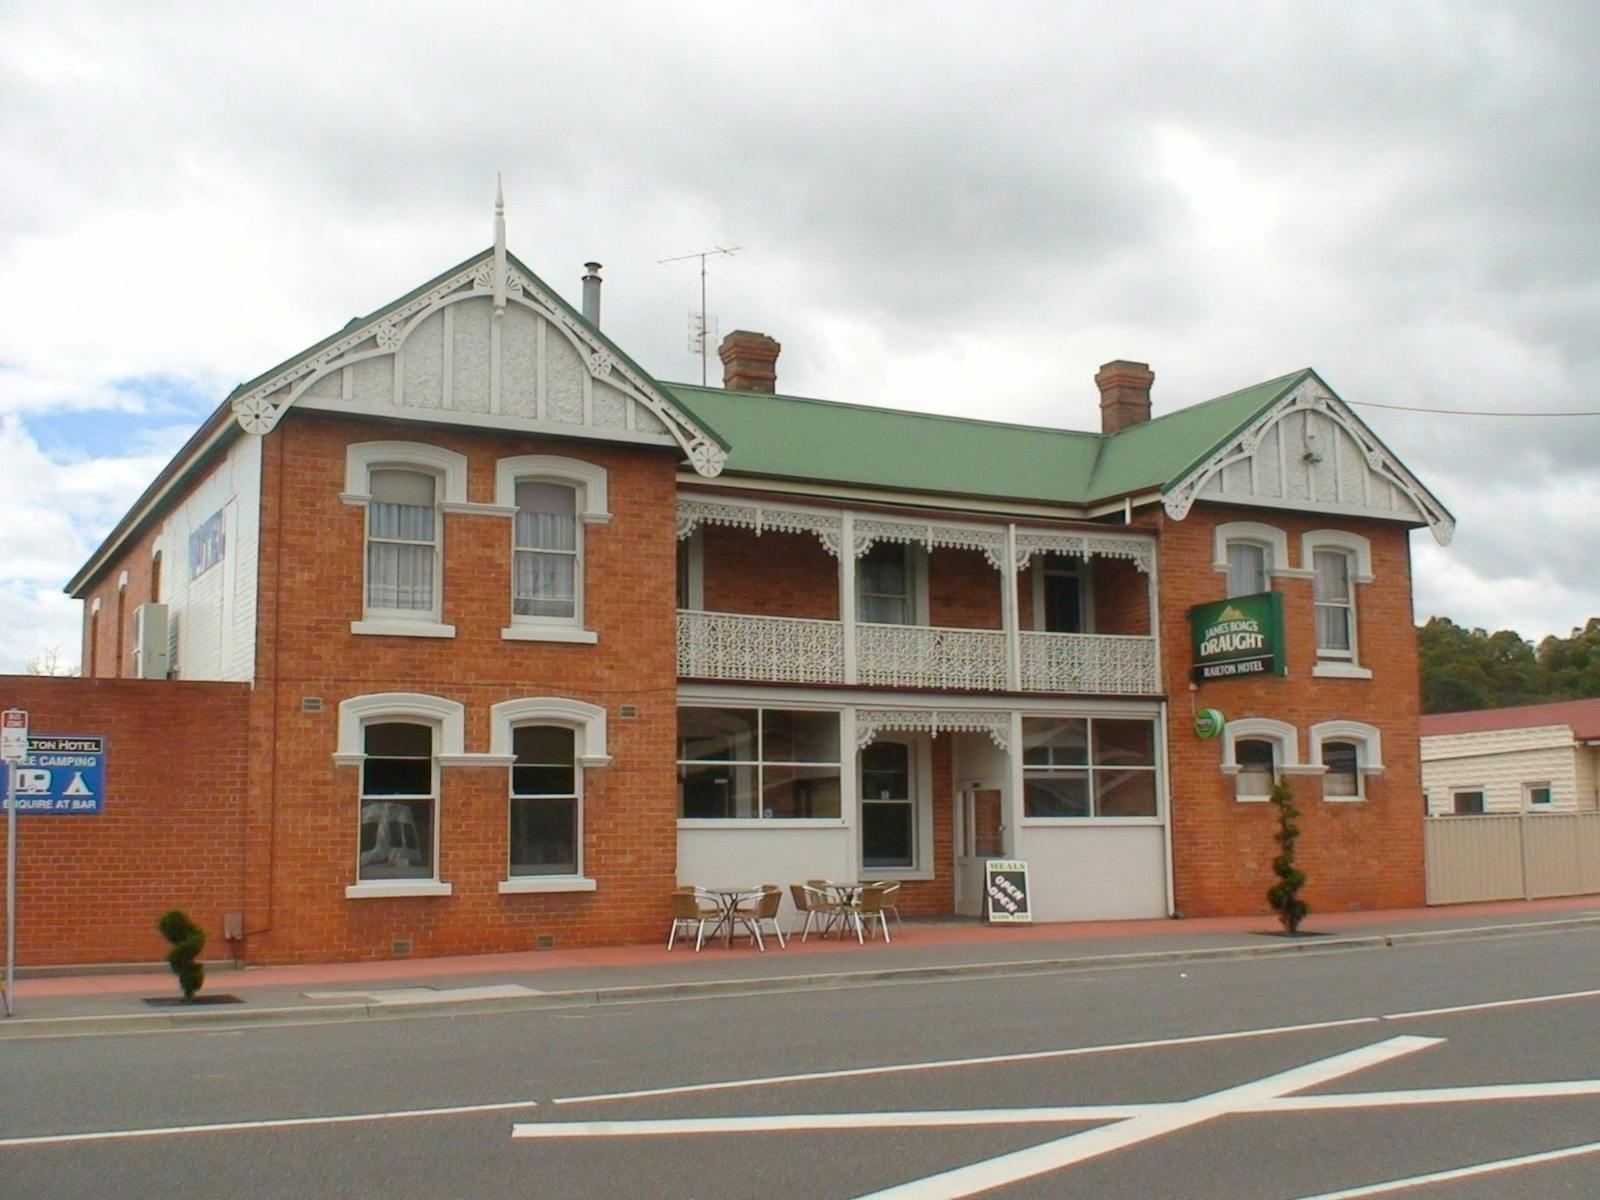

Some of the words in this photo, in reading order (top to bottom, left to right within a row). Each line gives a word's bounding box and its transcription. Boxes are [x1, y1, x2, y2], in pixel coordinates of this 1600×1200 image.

[1205, 622, 1229, 641] JAMES
[1200, 632, 1264, 656] DRAUGHT
[1203, 664, 1236, 678] RAILTON
[1237, 660, 1264, 674] HOTEL
[58, 740, 99, 751] HOTEL
[40, 756, 97, 767] CAMPING
[55, 800, 70, 809] AT
[72, 800, 97, 809] BAR
[995, 875, 1024, 901] OPEN
[989, 886, 1018, 912] OPEN
